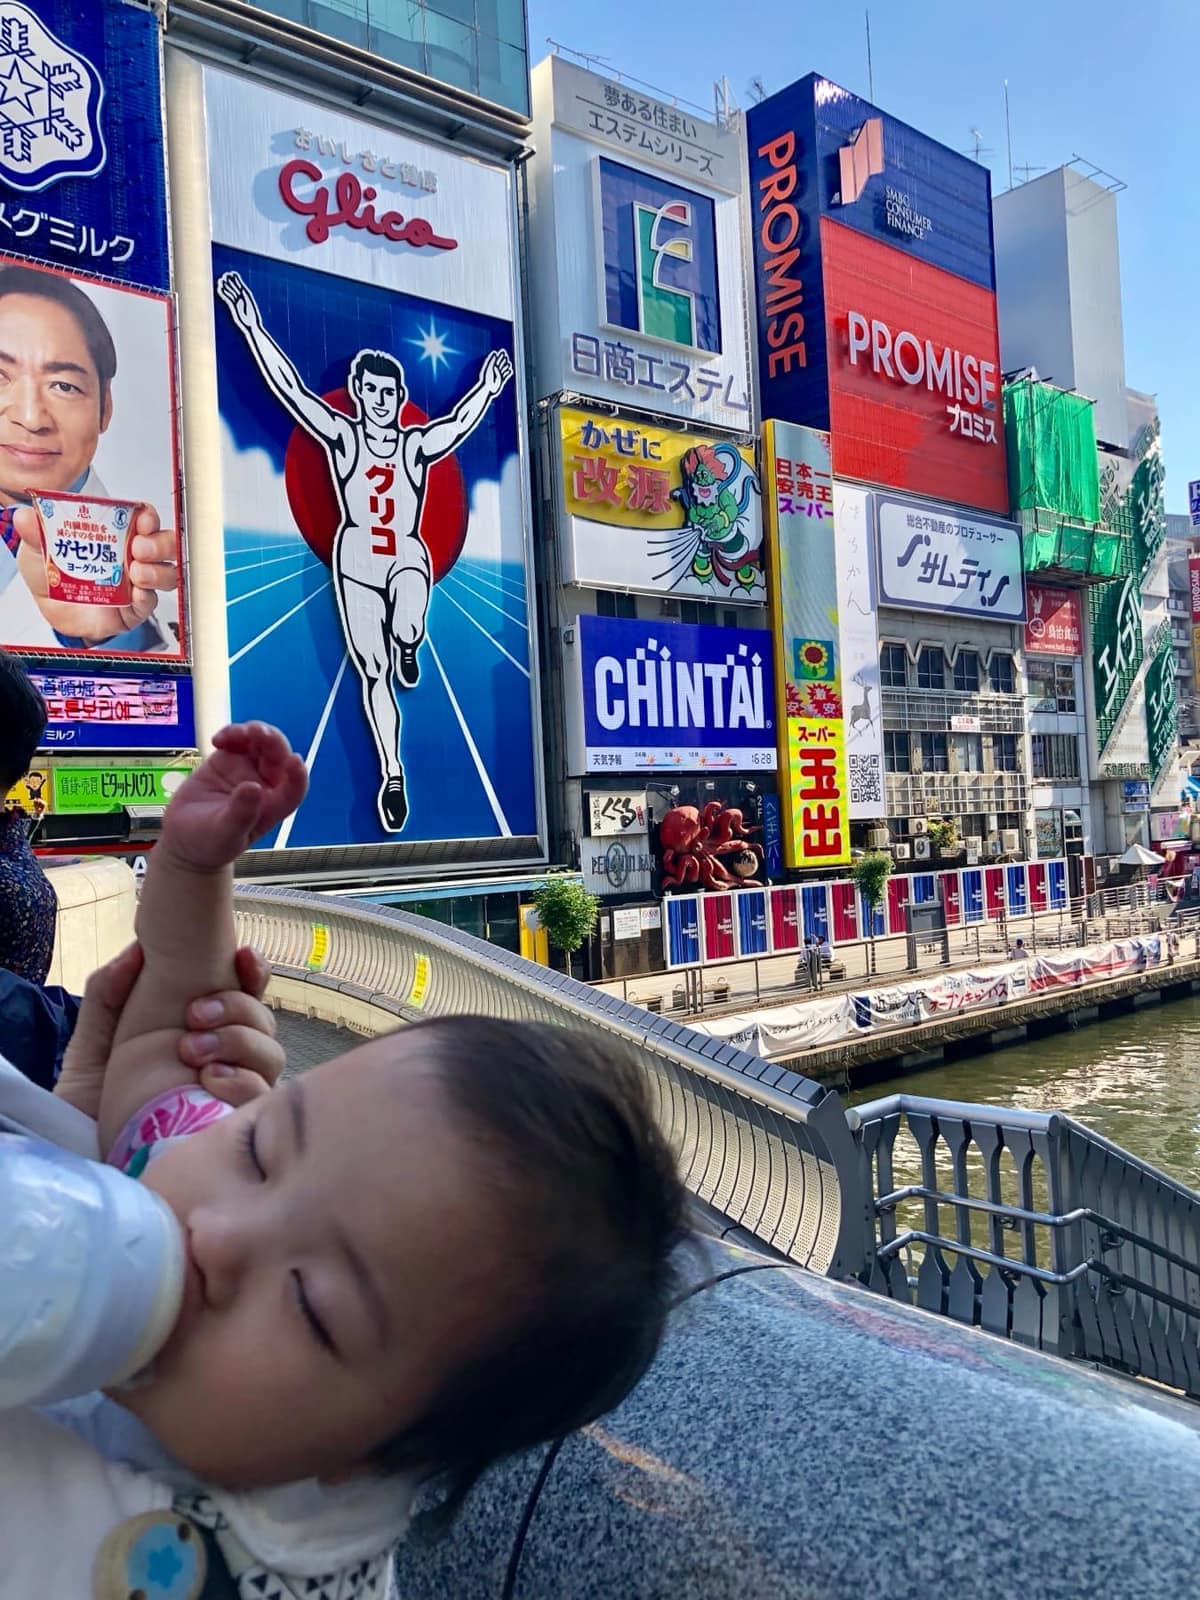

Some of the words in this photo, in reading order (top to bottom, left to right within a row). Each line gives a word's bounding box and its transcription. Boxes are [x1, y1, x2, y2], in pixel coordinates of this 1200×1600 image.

[604, 85, 698, 138] 夢ある住まい
[588, 110, 714, 176] エステムシリーズ
[279, 159, 458, 249] Glico
[885, 199, 934, 232] CONSUMER
[887, 211, 926, 240] FINANCE
[758, 130, 806, 378] PROMISE
[573, 332, 750, 411] 日商エステム
[848, 311, 997, 406] PROMISE
[581, 420, 662, 461] かぜに
[947, 404, 998, 444] プロミス
[573, 455, 673, 513] 改源
[776, 457, 831, 479] 日本一
[777, 477, 833, 503] 安売王
[365, 462, 397, 556] グリコ
[778, 496, 834, 519] スーパー
[906, 513, 1004, 544] 総合不動産のプロデューサー
[54, 538, 102, 561] ガセリ
[67, 562, 107, 574] ヨーグルト
[917, 551, 992, 593] サムティ
[39, 679, 117, 698] 道頓堀へ
[798, 726, 836, 743] スーパー
[592, 754, 623, 766] 天気予報
[101, 772, 157, 798] ピタットハウス
[601, 797, 637, 828] くくる
[799, 748, 842, 858] 玉出
